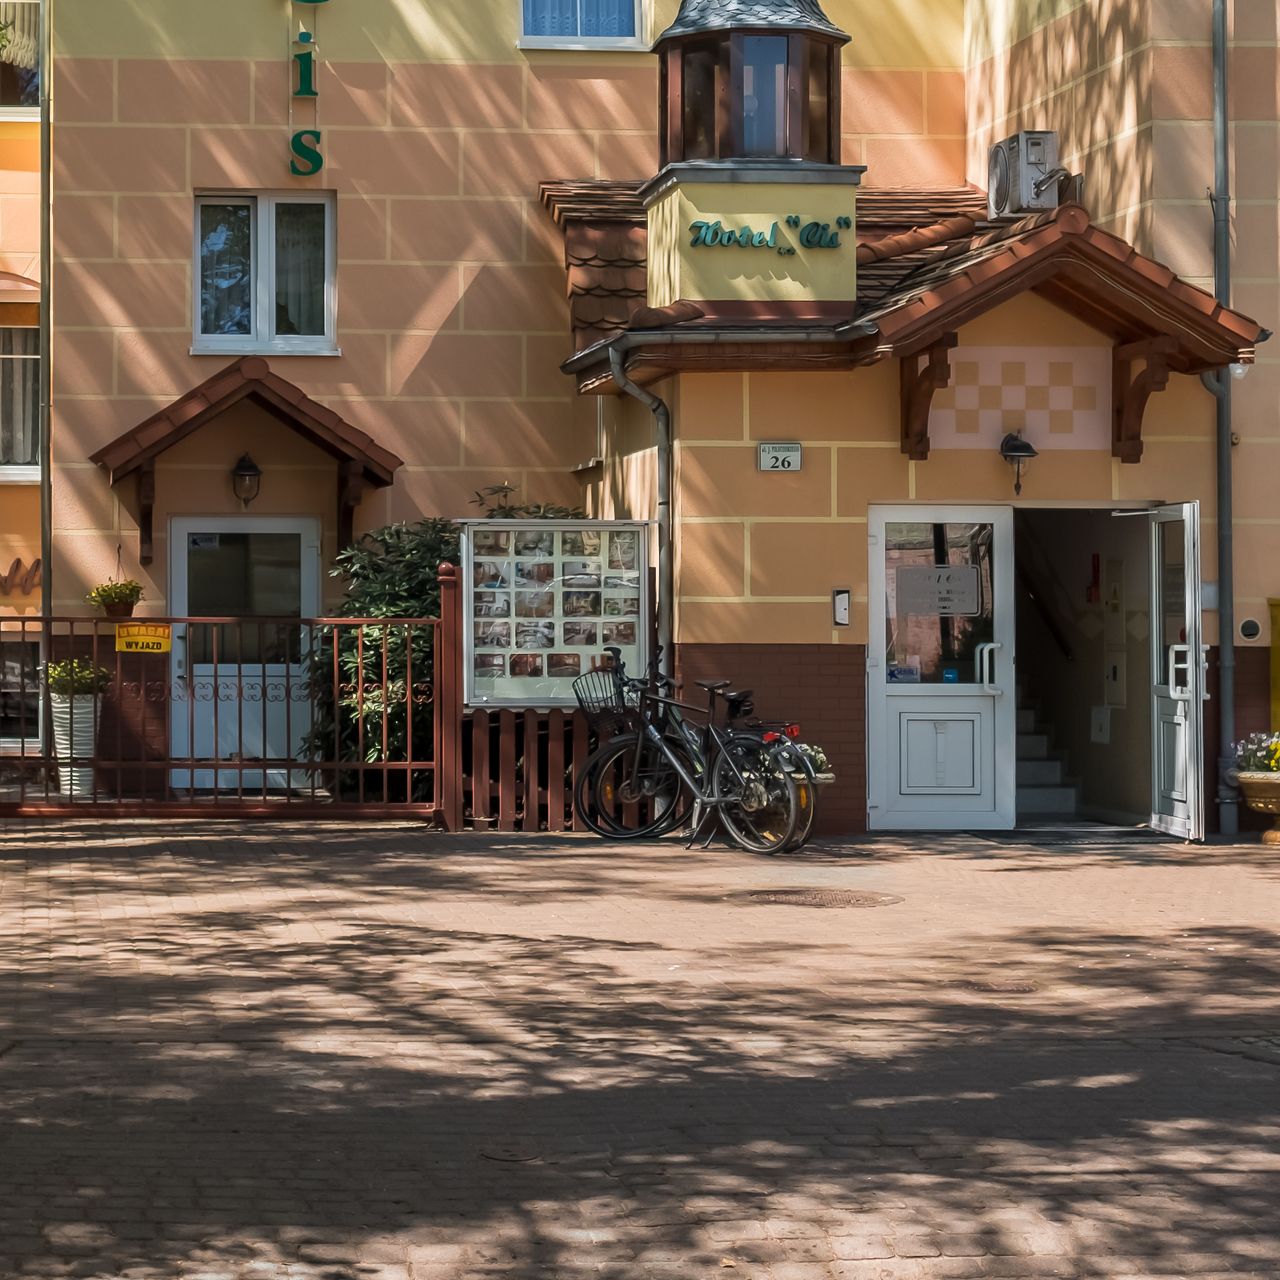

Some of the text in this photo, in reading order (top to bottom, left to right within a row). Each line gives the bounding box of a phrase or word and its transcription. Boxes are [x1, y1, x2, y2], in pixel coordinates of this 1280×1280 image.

[688, 220, 778, 248] Hotel
[770, 455, 792, 469] 26
[125, 641, 162, 650] WYJAZD
